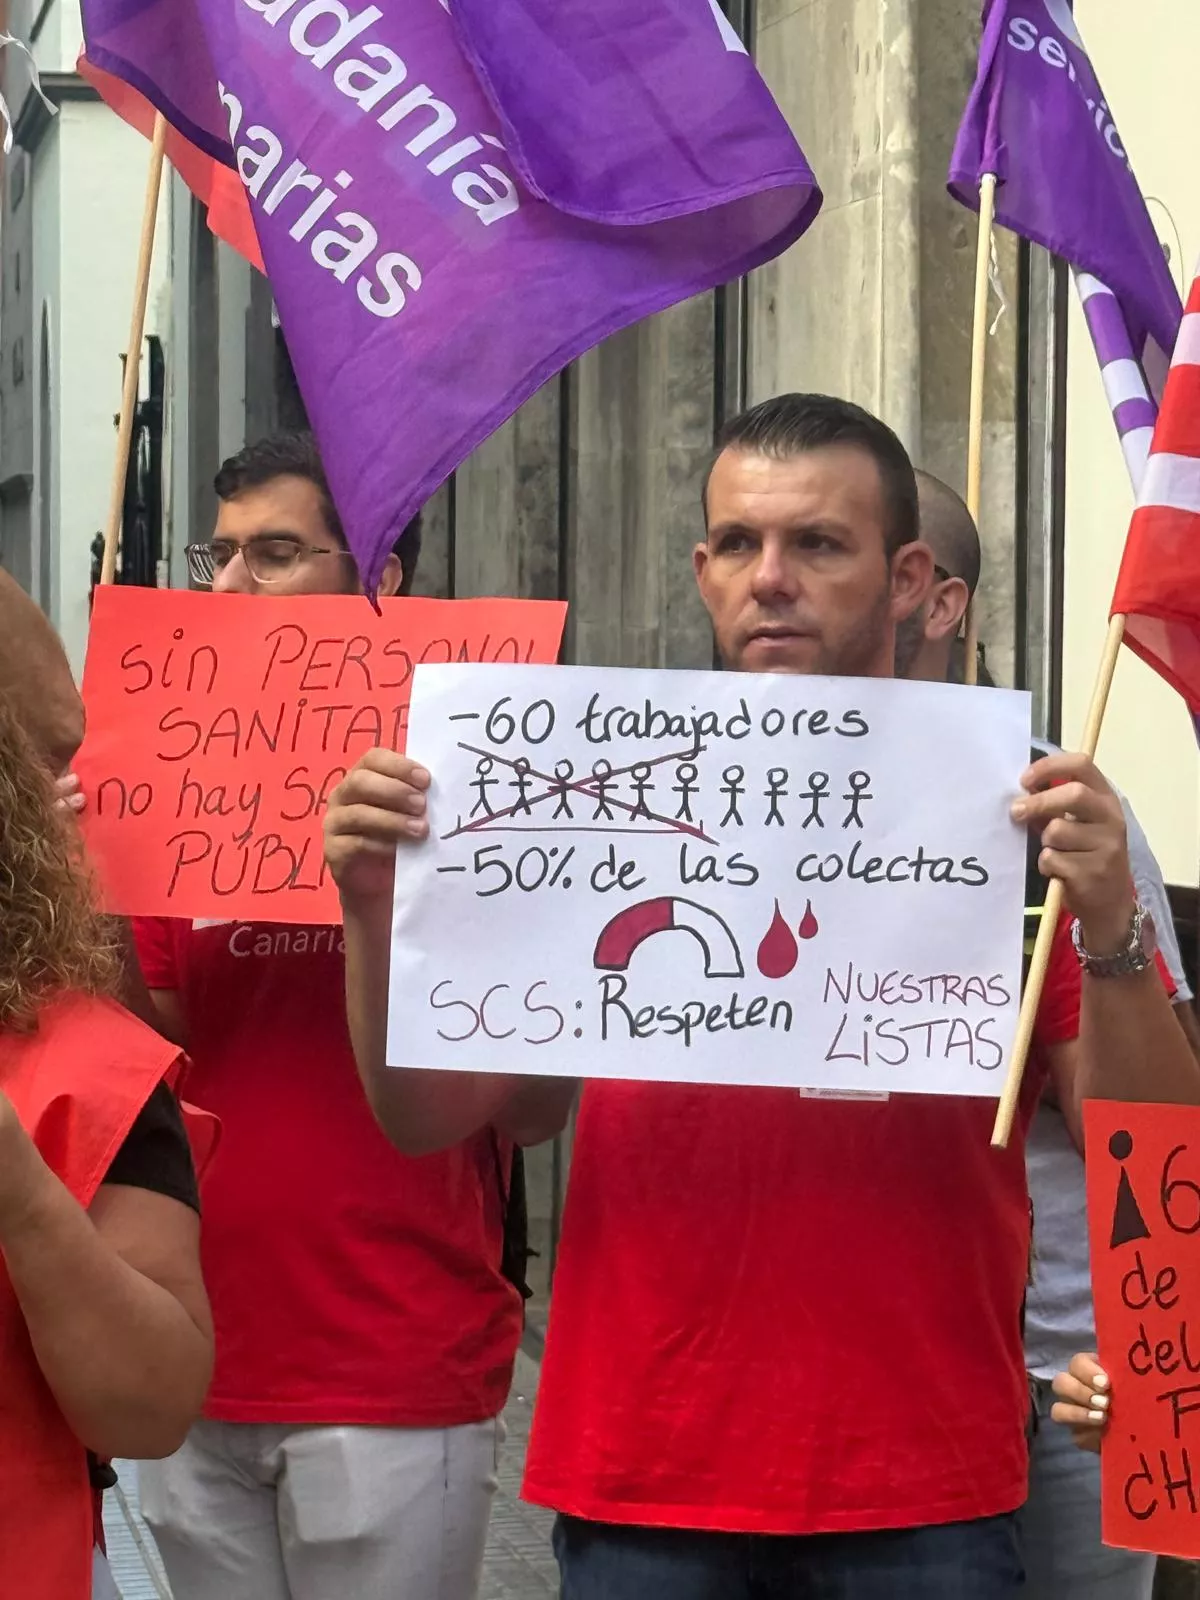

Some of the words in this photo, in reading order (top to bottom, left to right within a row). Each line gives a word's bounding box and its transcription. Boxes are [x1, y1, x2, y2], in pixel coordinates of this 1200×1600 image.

[449, 697, 555, 744] -60
[576, 693, 869, 761] trabajadores
[98, 776, 152, 818] no
[176, 768, 261, 842] hay
[437, 844, 575, 896] -50%
[590, 844, 647, 893] de
[680, 843, 759, 885] las
[796, 840, 989, 885] colectas
[430, 980, 582, 1044] SCS:
[598, 974, 792, 1047] Respeten
[824, 962, 1010, 1006] NUESTRAS
[1121, 1251, 1180, 1310] de
[1128, 1321, 1200, 1376] del
